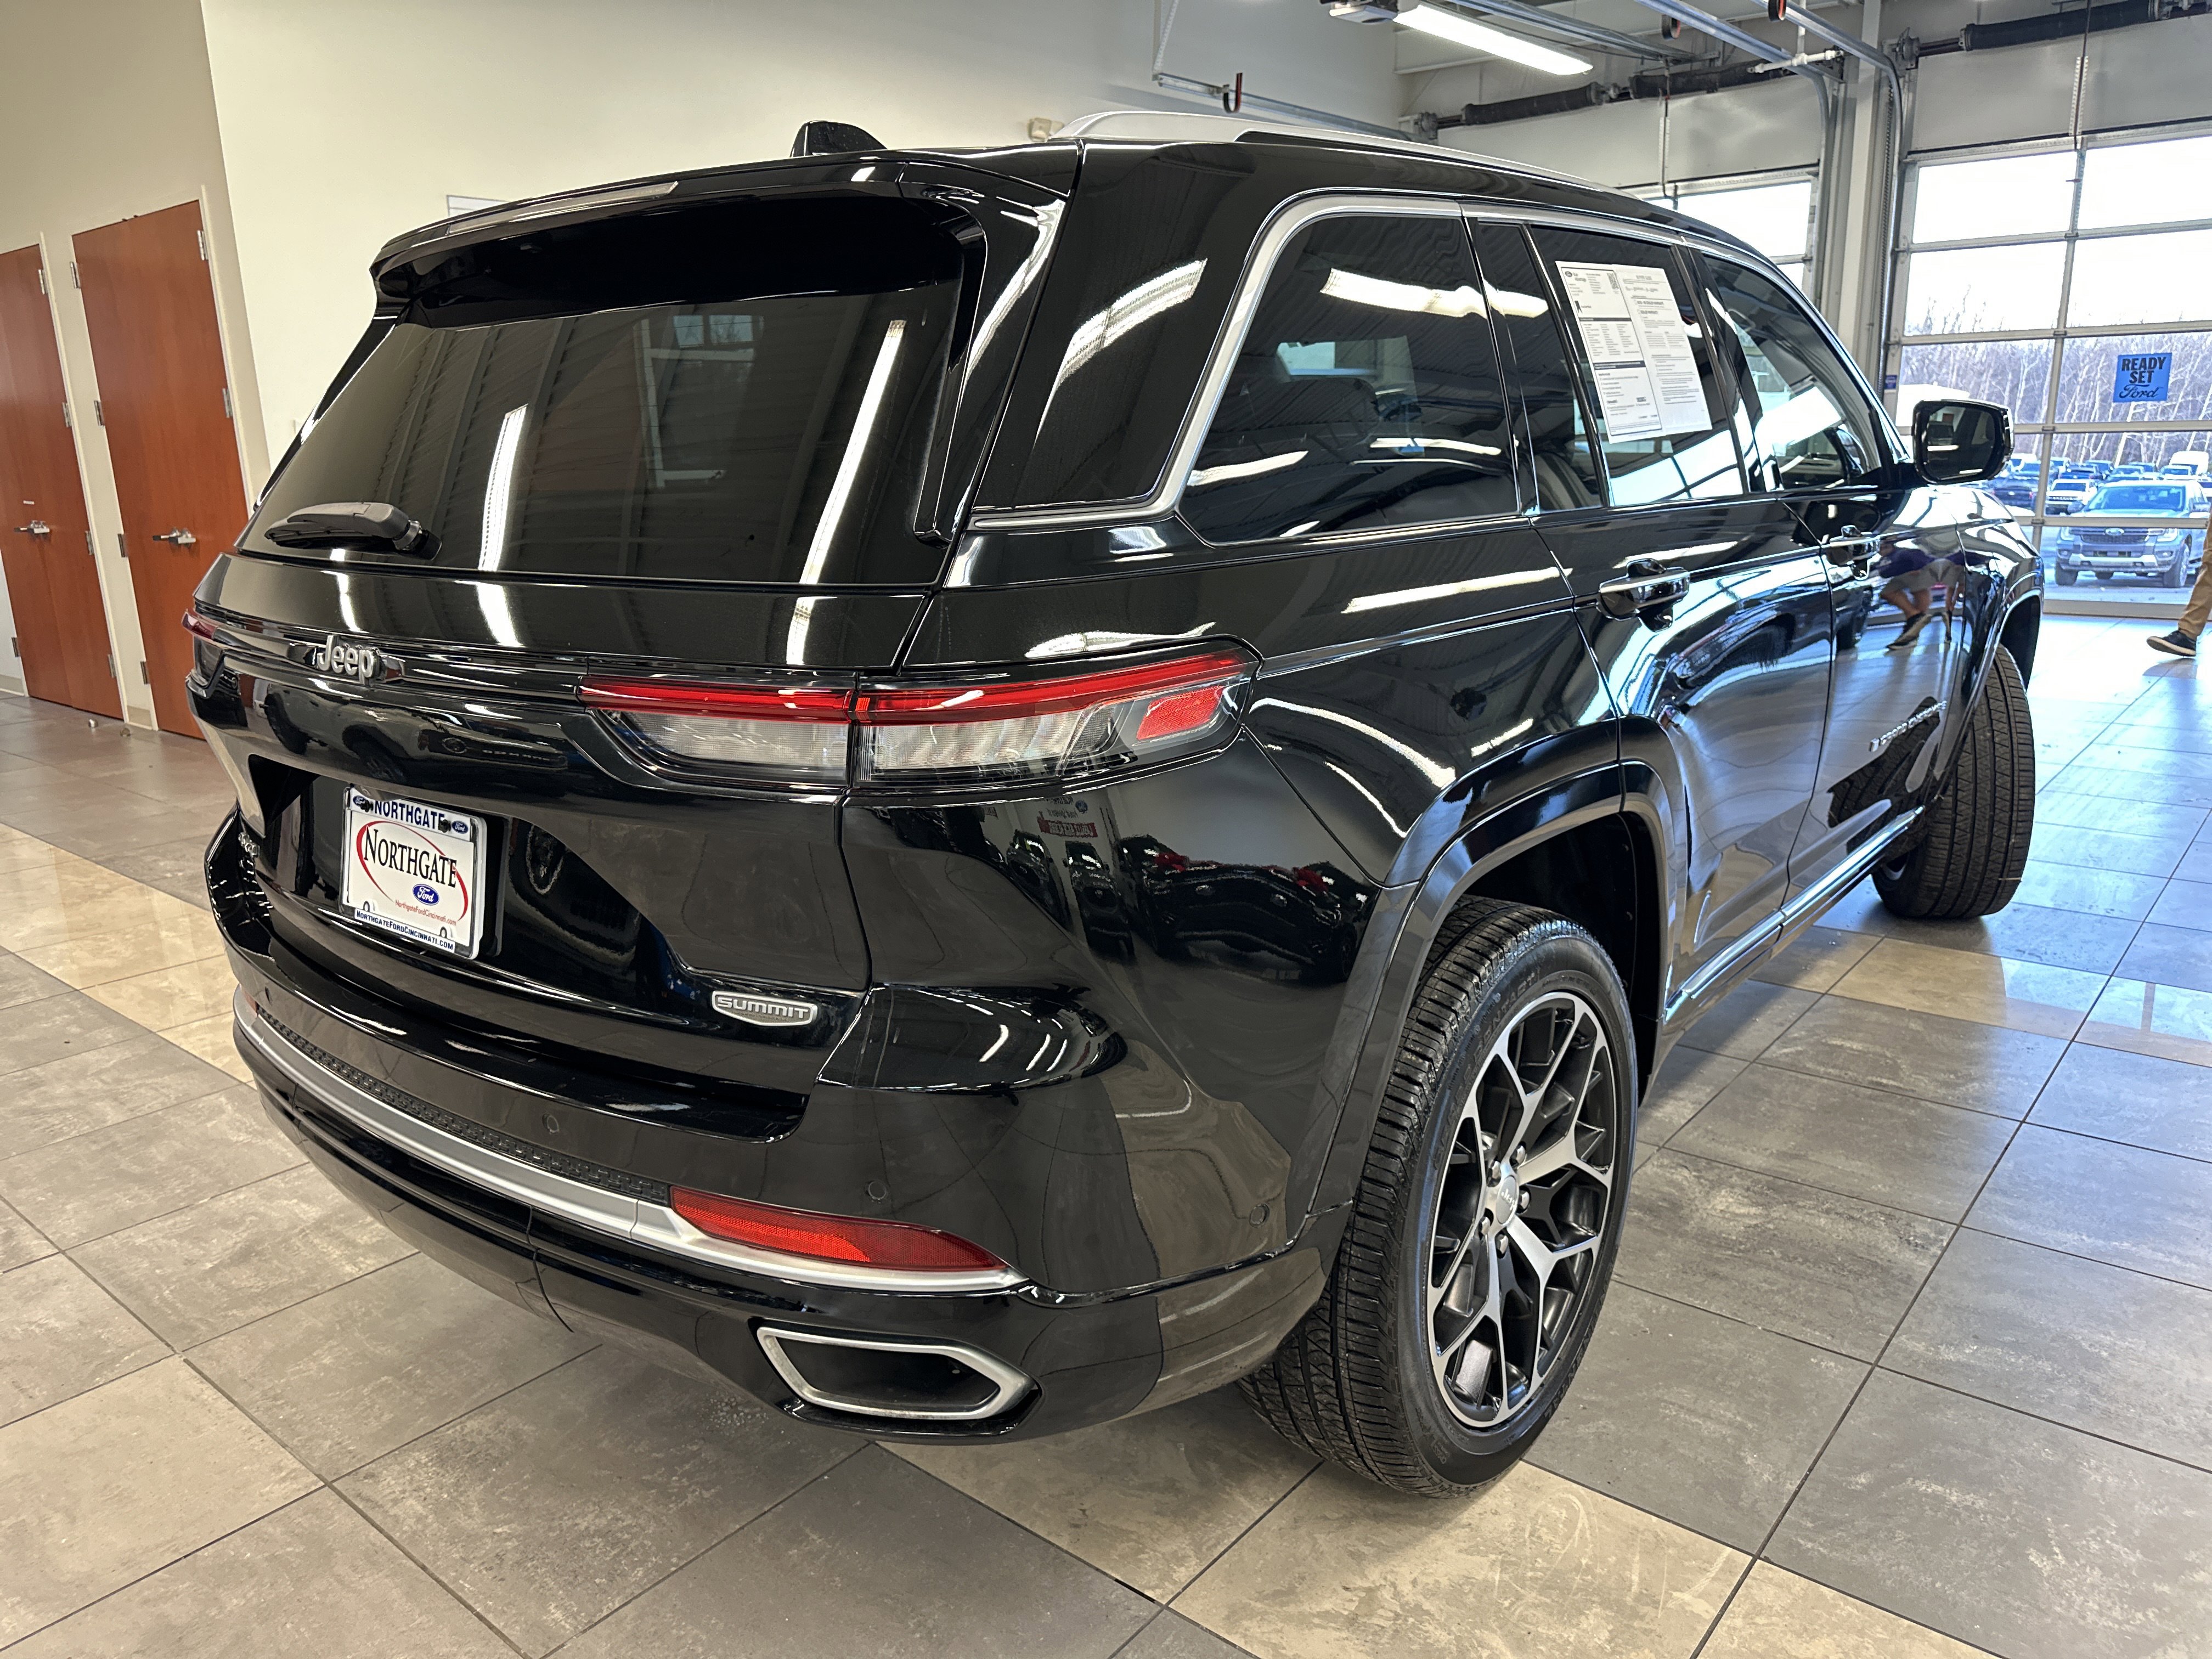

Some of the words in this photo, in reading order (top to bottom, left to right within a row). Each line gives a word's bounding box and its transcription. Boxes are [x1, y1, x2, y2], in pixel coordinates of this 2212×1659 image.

[2121, 357, 2166, 371] READY
[2129, 370, 2154, 383] SET
[2119, 384, 2164, 398] Ford
[317, 635, 374, 685] Jeep
[364, 827, 457, 888] NORTHGATE
[416, 886, 435, 902] Ford
[395, 900, 456, 926] NorthgateFordCincinnati.com
[717, 997, 808, 1019] SUMMIT
